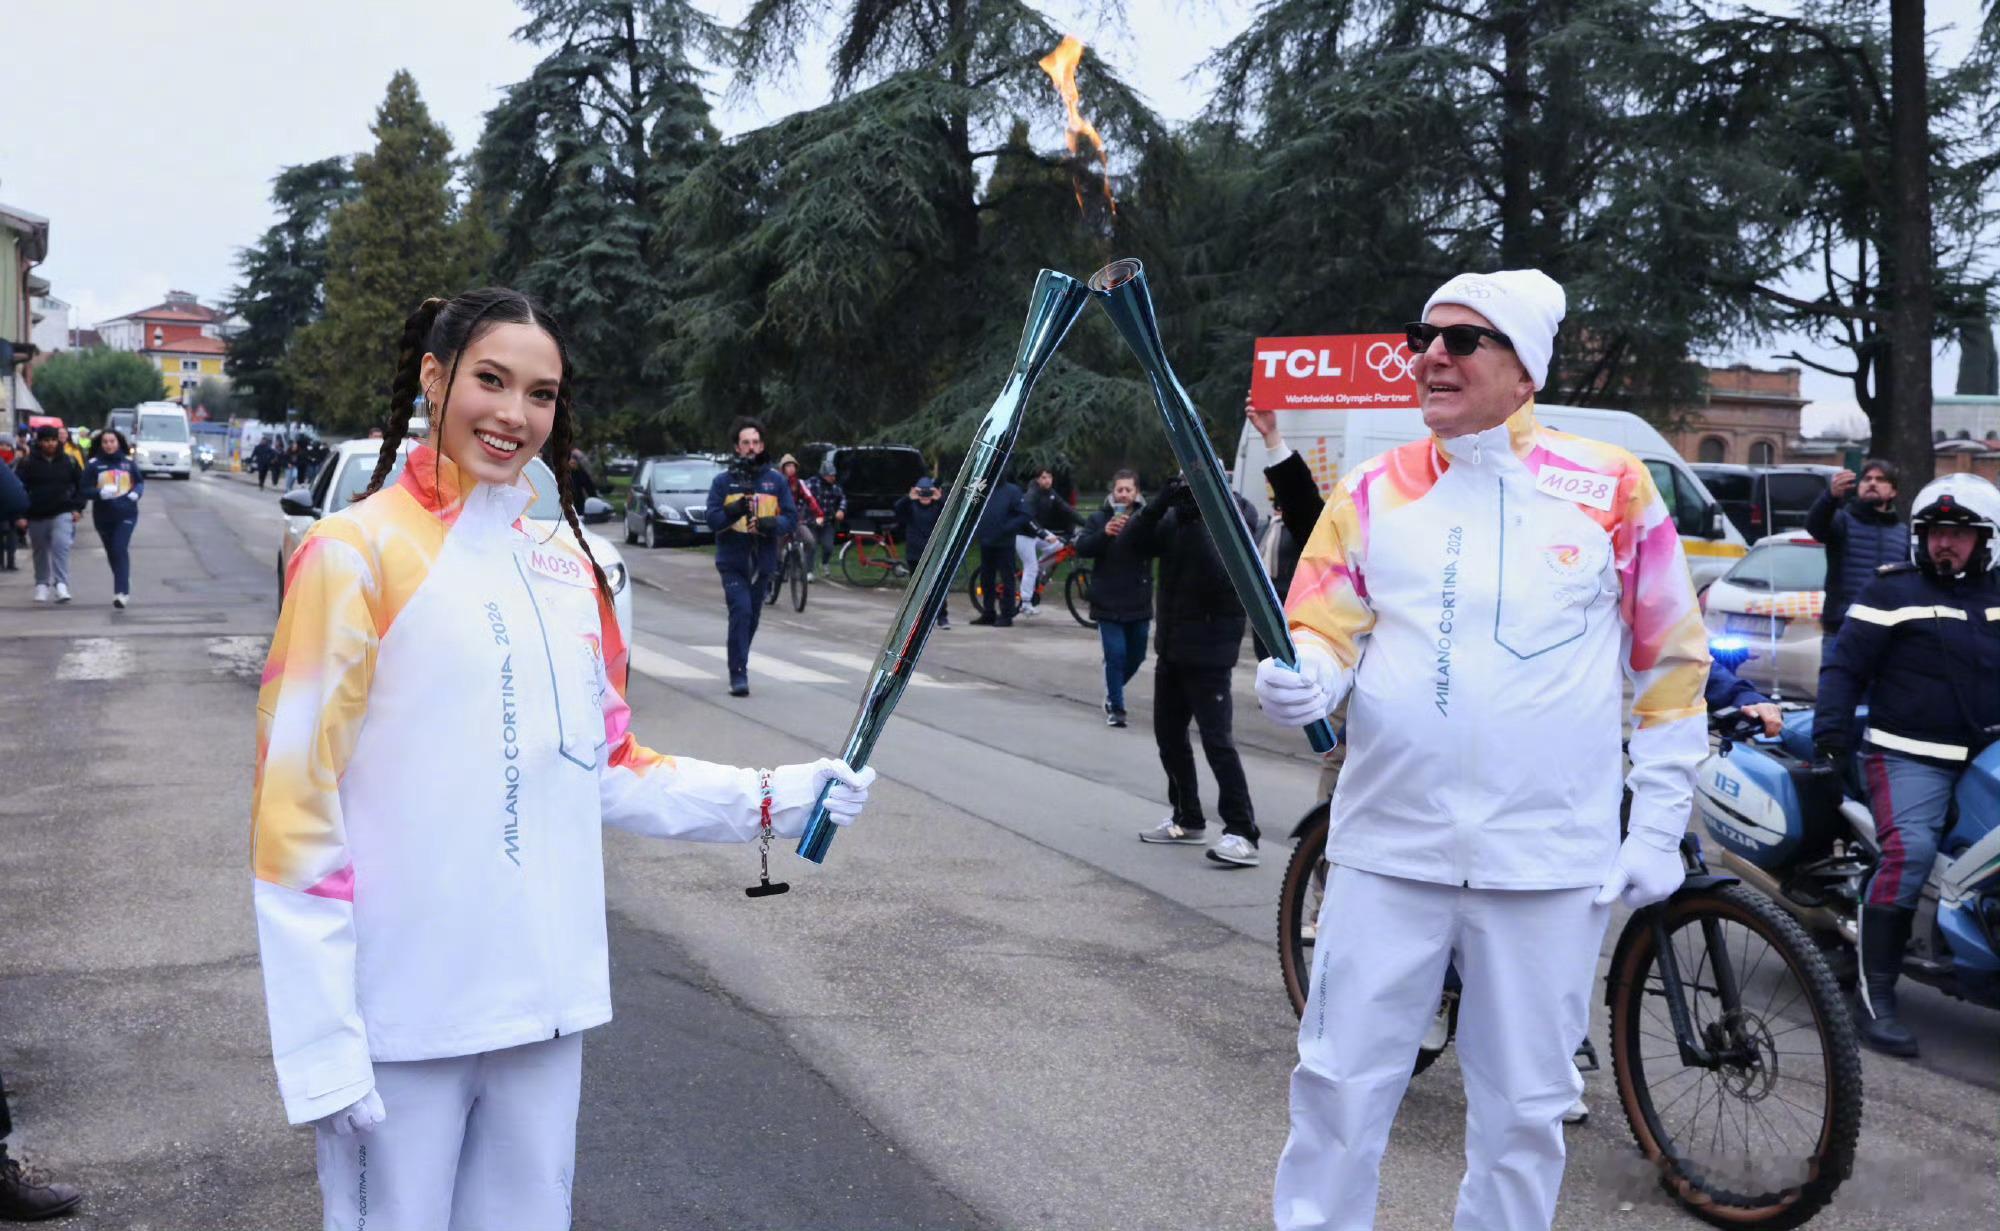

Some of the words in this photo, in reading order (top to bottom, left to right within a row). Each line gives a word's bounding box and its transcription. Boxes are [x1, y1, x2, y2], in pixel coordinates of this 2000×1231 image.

[1258, 349, 1342, 378] TCL
[1285, 394, 1335, 404] Worldwide
[1336, 393, 1373, 405] Olympic
[1374, 392, 1412, 403] Partner
[1542, 473, 1609, 499] M038
[1447, 525, 1463, 556] 2026
[531, 550, 580, 579] M039
[1439, 560, 1457, 634] CORTINA
[484, 600, 511, 646] 2026
[1435, 638, 1452, 717] MILANO
[501, 653, 519, 760] CORTINA
[1715, 771, 1740, 798] 113
[504, 765, 521, 866] MILANO
[359, 1144, 367, 1168] 2026
[359, 1170, 367, 1217] CORTINA
